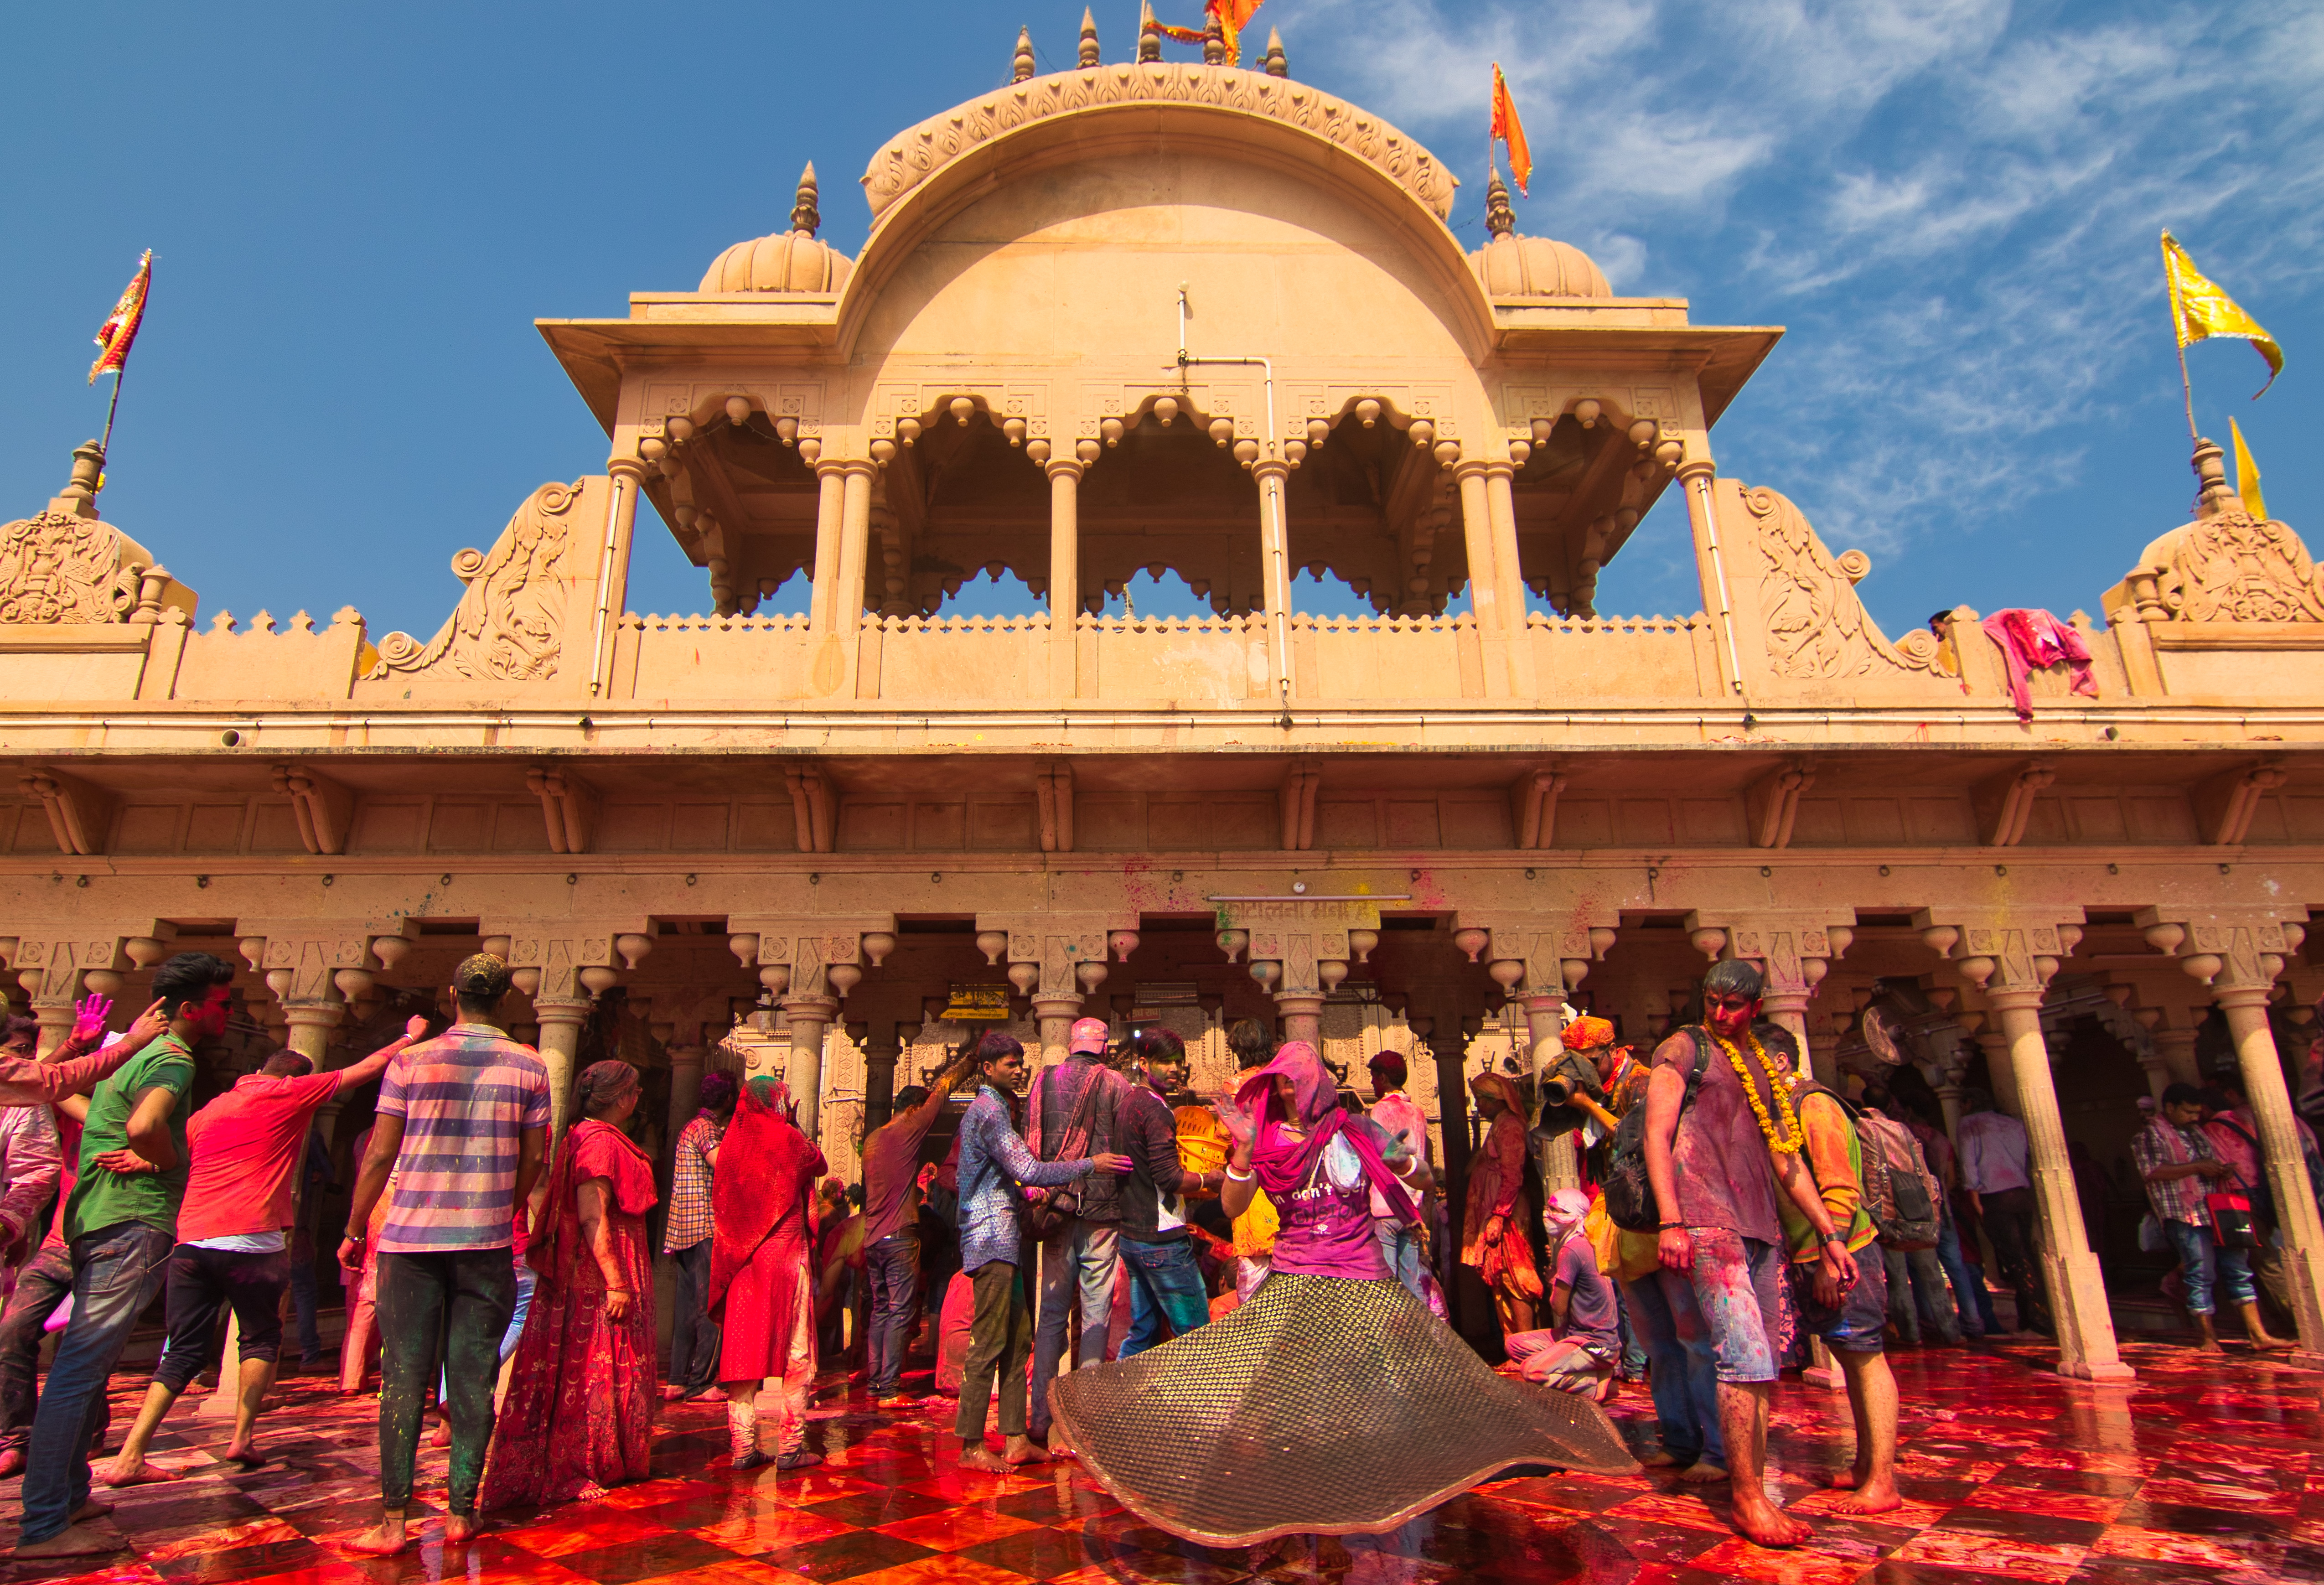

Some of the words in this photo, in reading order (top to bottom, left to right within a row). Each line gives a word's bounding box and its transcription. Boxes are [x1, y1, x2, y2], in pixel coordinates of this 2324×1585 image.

[1145, 1007, 1158, 1016] राध
[1270, 1194, 1285, 1205] in
[1292, 1183, 1332, 1201] don't
[1283, 1201, 1361, 1224] TENSION
